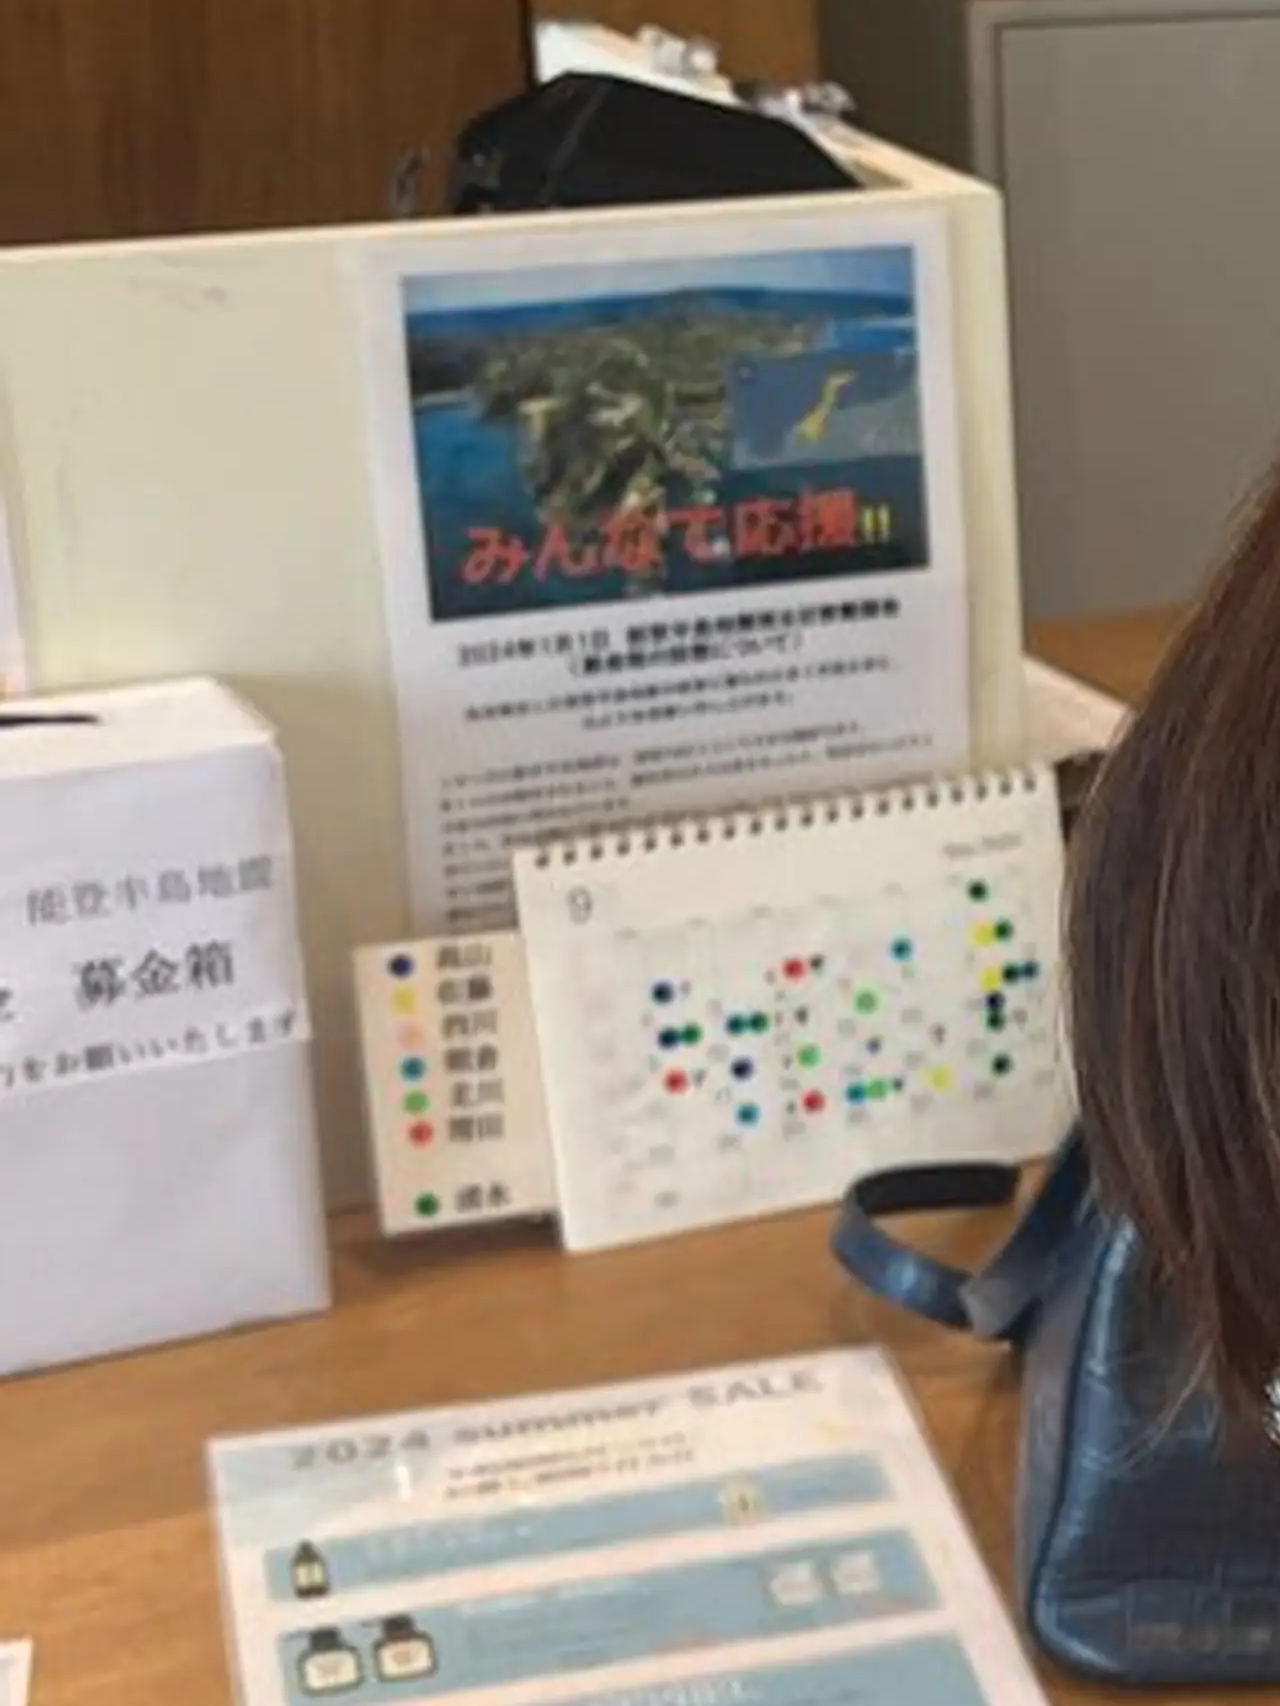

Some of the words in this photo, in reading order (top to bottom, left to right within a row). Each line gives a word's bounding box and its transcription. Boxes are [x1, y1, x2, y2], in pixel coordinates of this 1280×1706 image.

[26, 855, 273, 926] 能登半島地震
[70, 938, 235, 1011] 募金箱
[289, 1429, 430, 1470] 2024
[452, 1398, 664, 1446] summer
[688, 1369, 824, 1407] SALE
